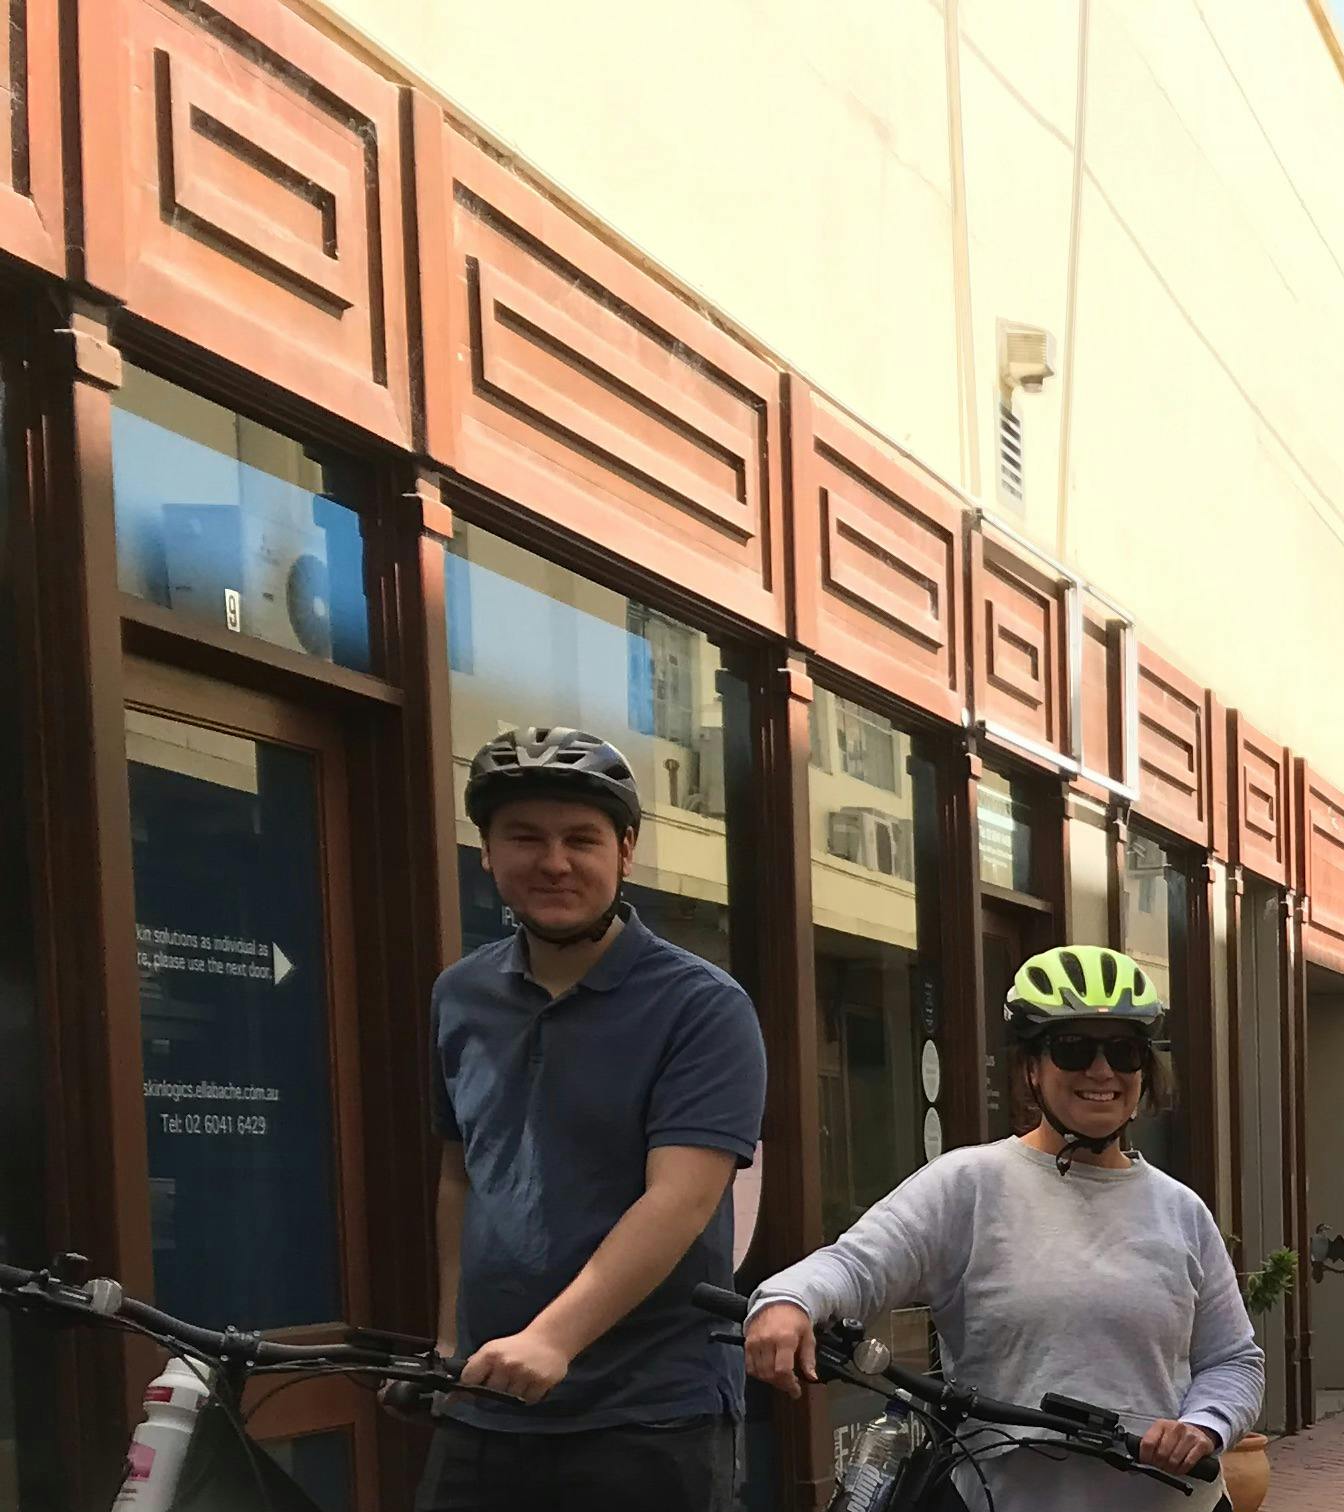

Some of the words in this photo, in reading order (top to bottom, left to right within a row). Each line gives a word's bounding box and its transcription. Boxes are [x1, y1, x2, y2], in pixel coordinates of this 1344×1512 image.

[228, 594, 238, 628] 9
[136, 925, 151, 941] kin
[153, 927, 198, 949] solutions
[200, 935, 212, 950] as
[213, 936, 256, 956] individual
[258, 943, 269, 957] as
[153, 951, 186, 973] please
[188, 957, 205, 972] use
[207, 957, 224, 974] the
[225, 960, 247, 977] next
[160, 1114, 182, 1134] Tel:
[185, 1114, 201, 1134] 02
[204, 1114, 233, 1134] 6041
[237, 1115, 267, 1135] 6429
